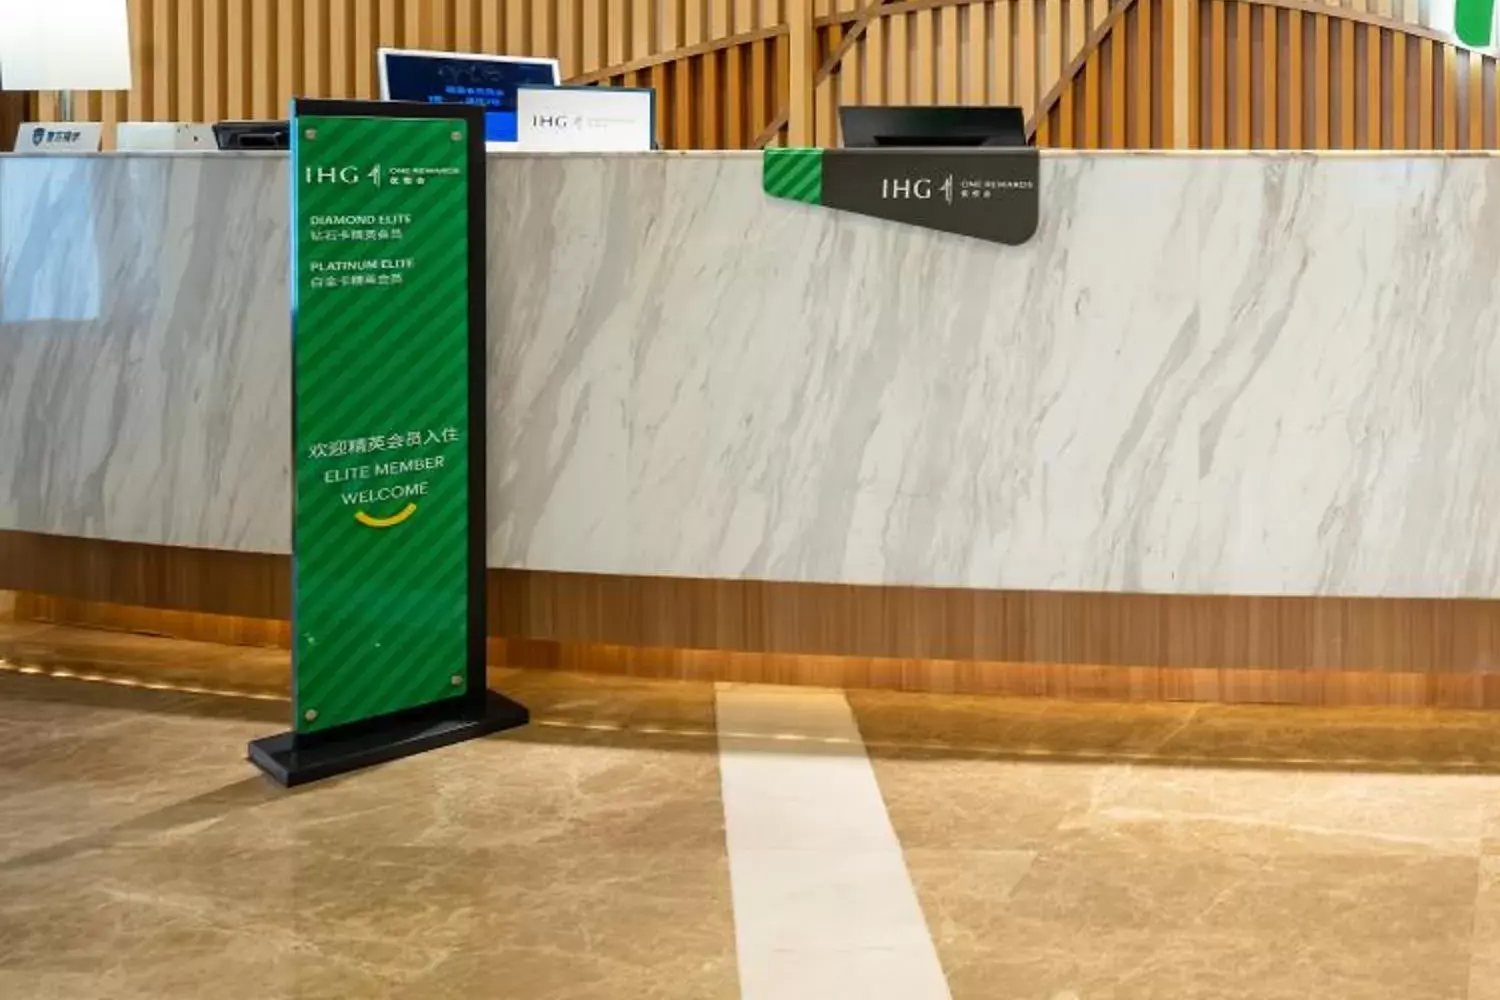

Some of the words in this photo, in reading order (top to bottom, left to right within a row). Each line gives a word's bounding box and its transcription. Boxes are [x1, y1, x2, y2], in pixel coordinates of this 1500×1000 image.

[532, 114, 568, 128] IHG
[306, 166, 358, 184] IHG
[882, 179, 931, 199] IHG
[310, 215, 376, 226] DIAMOND
[378, 214, 412, 225] ELITE
[310, 259, 378, 272] PLATINUM
[381, 258, 414, 269] ELITE
[308, 427, 460, 458] 欢迎精英会员入住
[323, 465, 371, 484] ELITE
[374, 455, 445, 477] MEMBER
[341, 481, 429, 505] WELCOME
